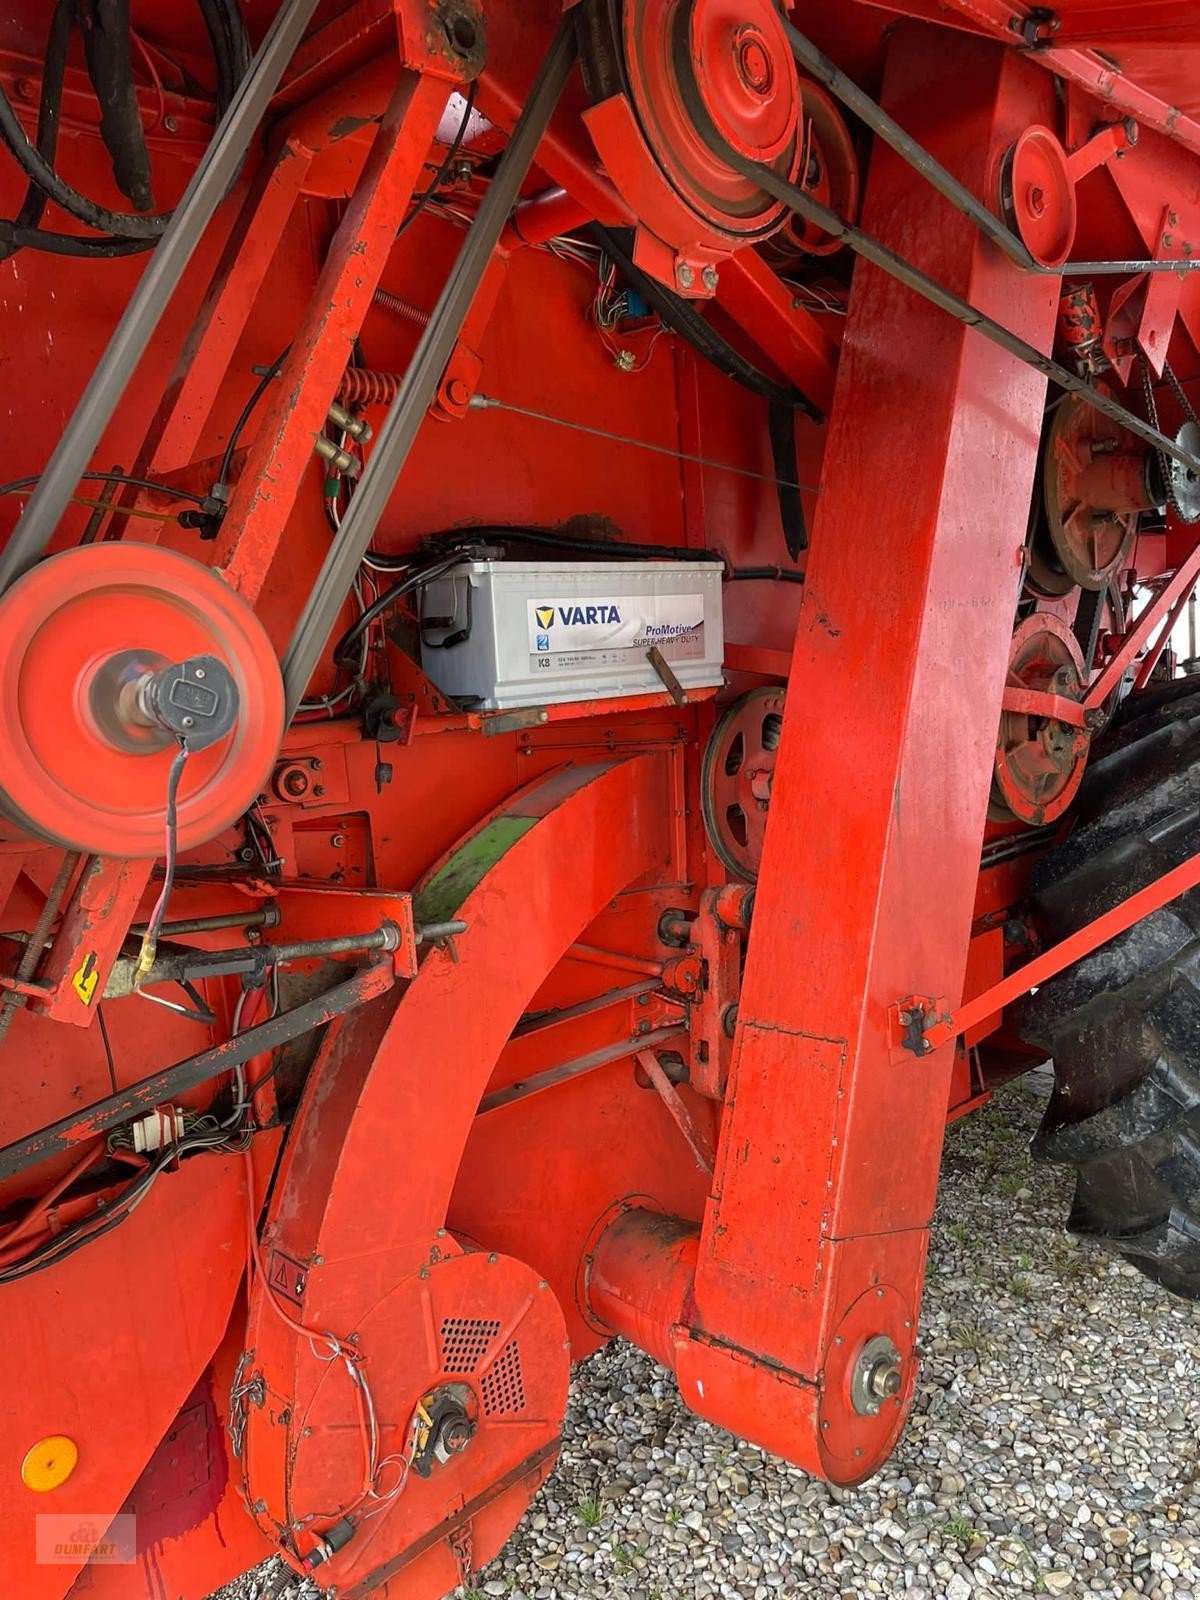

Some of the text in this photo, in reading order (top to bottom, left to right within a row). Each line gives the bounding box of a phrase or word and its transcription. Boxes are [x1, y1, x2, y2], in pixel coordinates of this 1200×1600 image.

[559, 605, 621, 626] VARTA
[645, 624, 692, 636] ProMotive
[633, 635, 698, 647] SUPER HEAVY DUTY
[538, 658, 550, 668] K8
